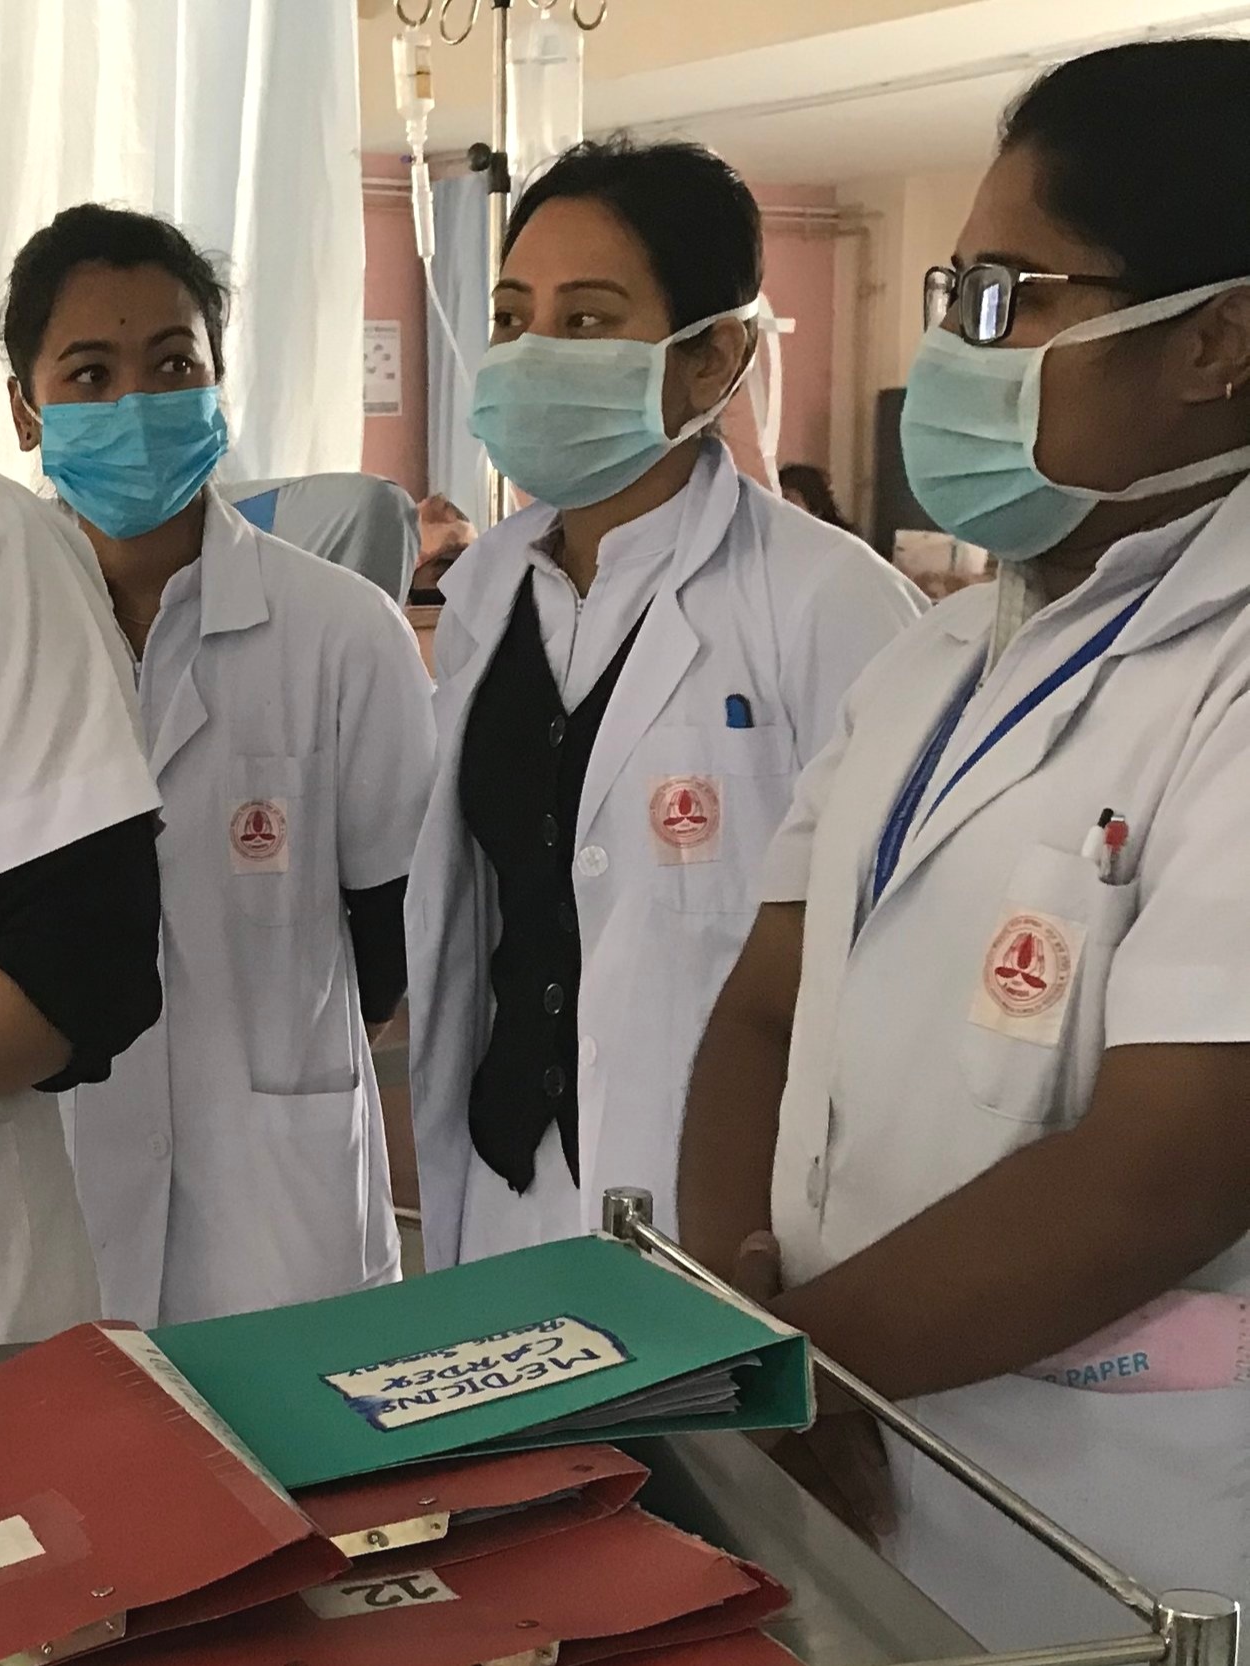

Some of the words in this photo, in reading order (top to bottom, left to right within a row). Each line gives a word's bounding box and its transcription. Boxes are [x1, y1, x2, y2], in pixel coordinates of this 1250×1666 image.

[380, 1337, 564, 1393] CARDEX
[1065, 1351, 1150, 1388] PAPER
[340, 1574, 439, 1607] 12
